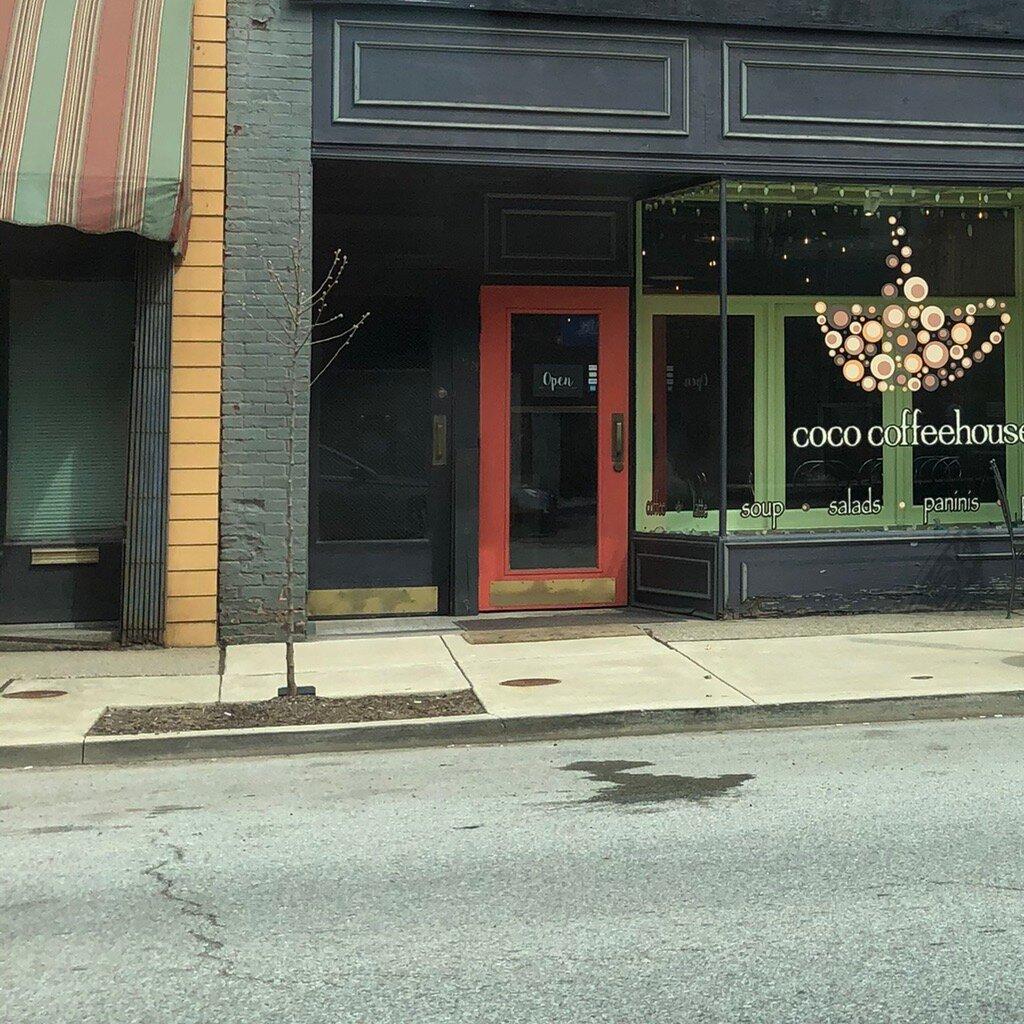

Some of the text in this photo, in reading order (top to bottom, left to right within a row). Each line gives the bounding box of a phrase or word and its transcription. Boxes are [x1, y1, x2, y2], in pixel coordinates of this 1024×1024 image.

[543, 371, 575, 392] Open
[792, 425, 862, 448] coco
[740, 499, 785, 530] soup
[828, 486, 882, 515] salads
[923, 489, 980, 525] paninis
